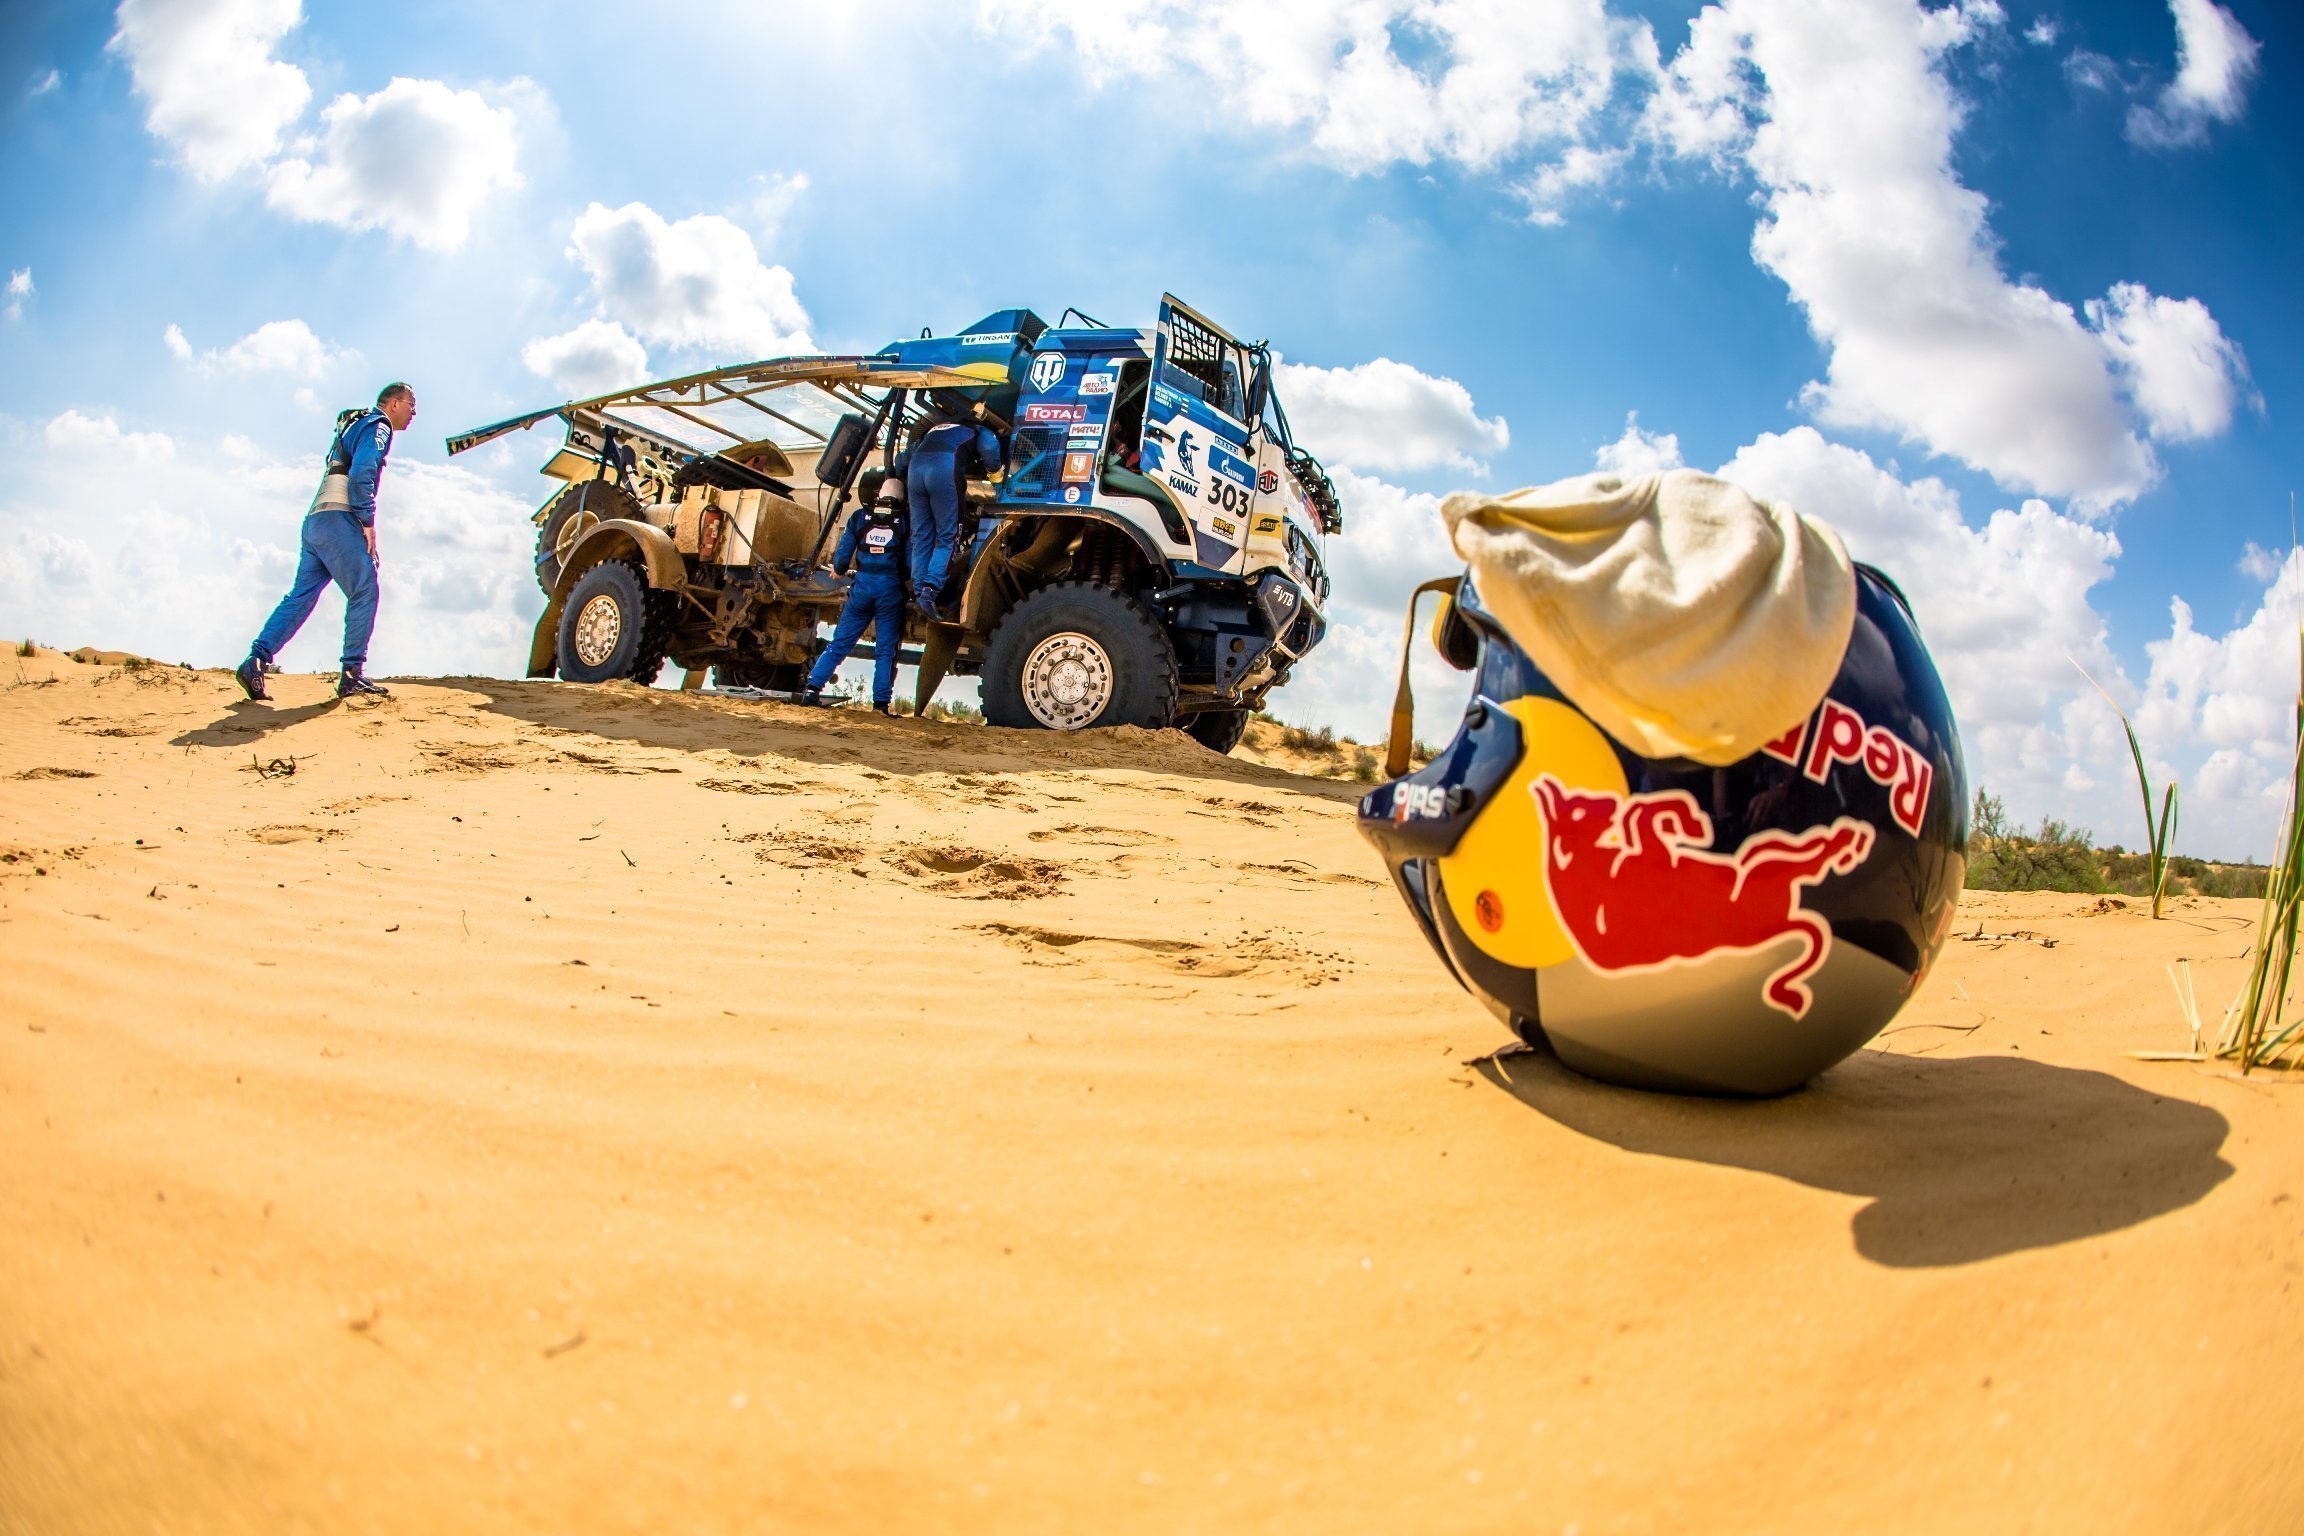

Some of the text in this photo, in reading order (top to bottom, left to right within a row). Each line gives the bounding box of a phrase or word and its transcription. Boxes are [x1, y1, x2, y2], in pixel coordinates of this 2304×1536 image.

[1168, 475, 1198, 497] KAMAZ
[1207, 475, 1250, 519] 303
[1277, 588, 1295, 607] VTB
[1803, 697, 1933, 839] Red
